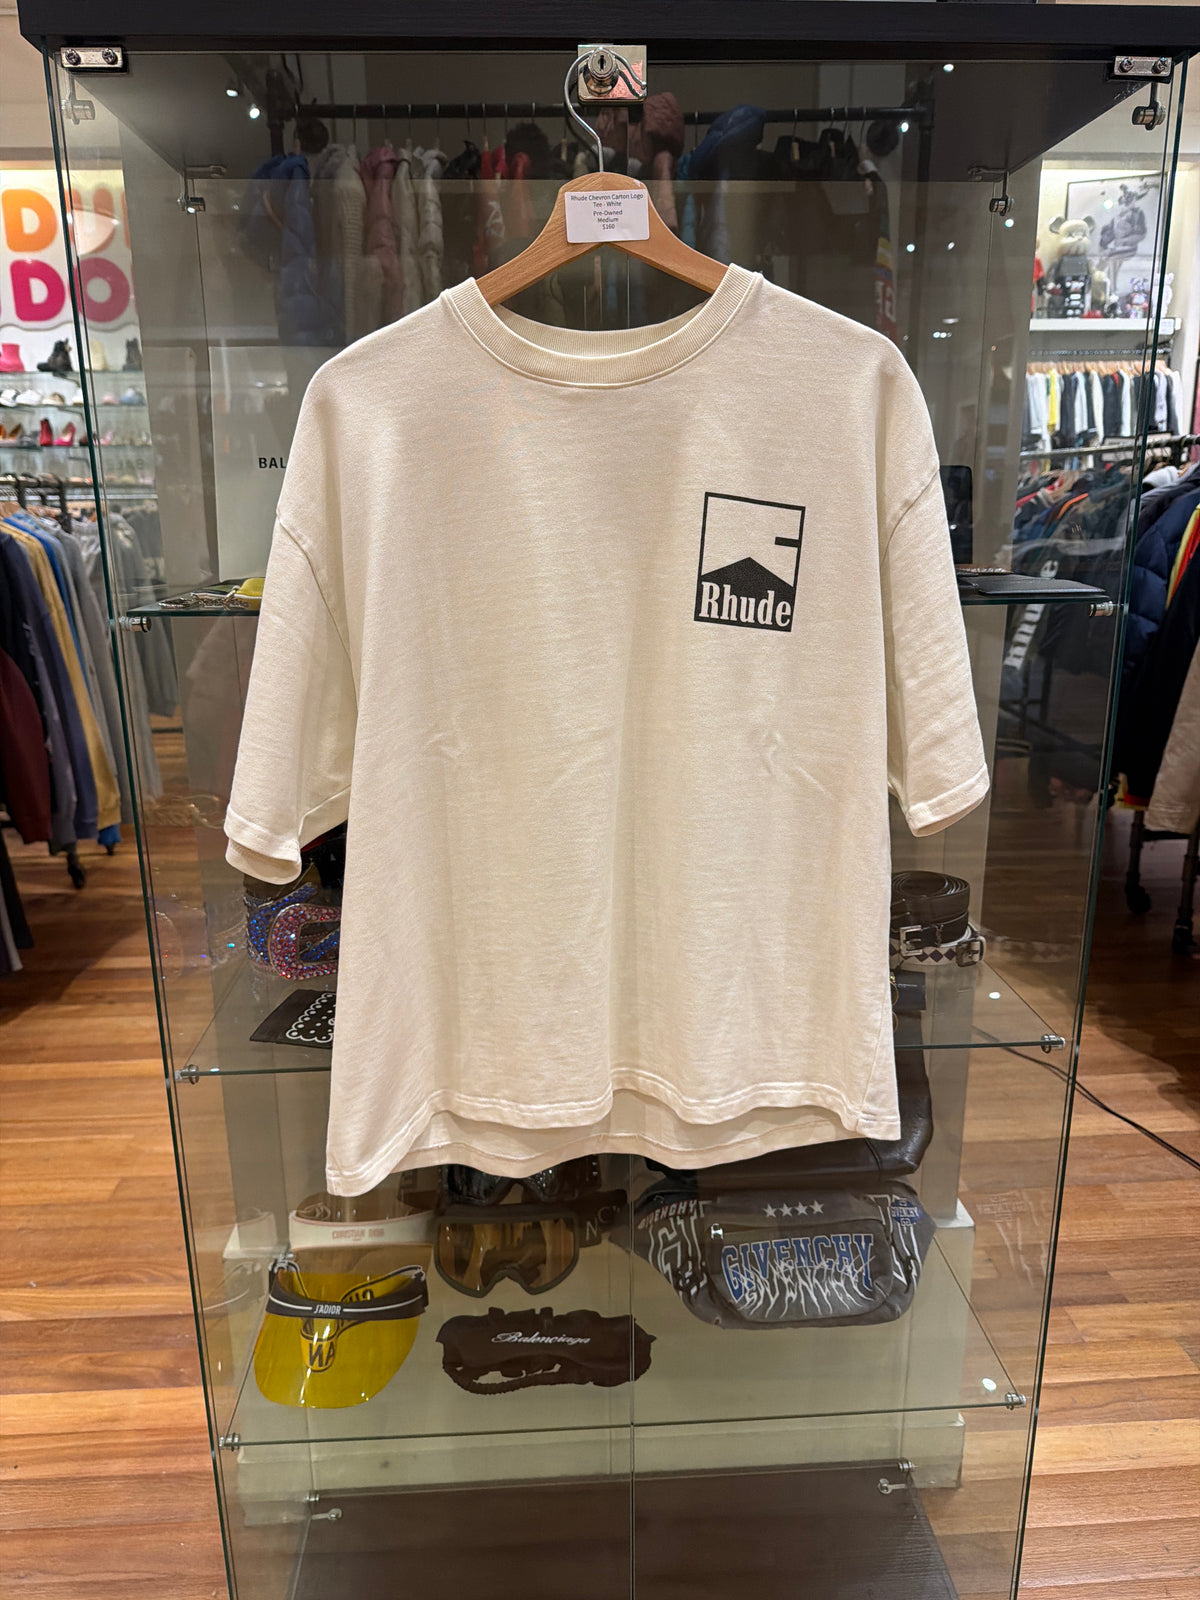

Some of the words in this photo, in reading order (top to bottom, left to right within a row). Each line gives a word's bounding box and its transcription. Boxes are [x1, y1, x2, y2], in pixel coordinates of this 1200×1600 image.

[1, 188, 131, 254] DU
[0, 257, 138, 323] DO
[258, 457, 288, 469] BAL
[698, 581, 792, 627] Rhude
[721, 1234, 875, 1303] GIVENCHY
[491, 1331, 591, 1345] Balenciaga
